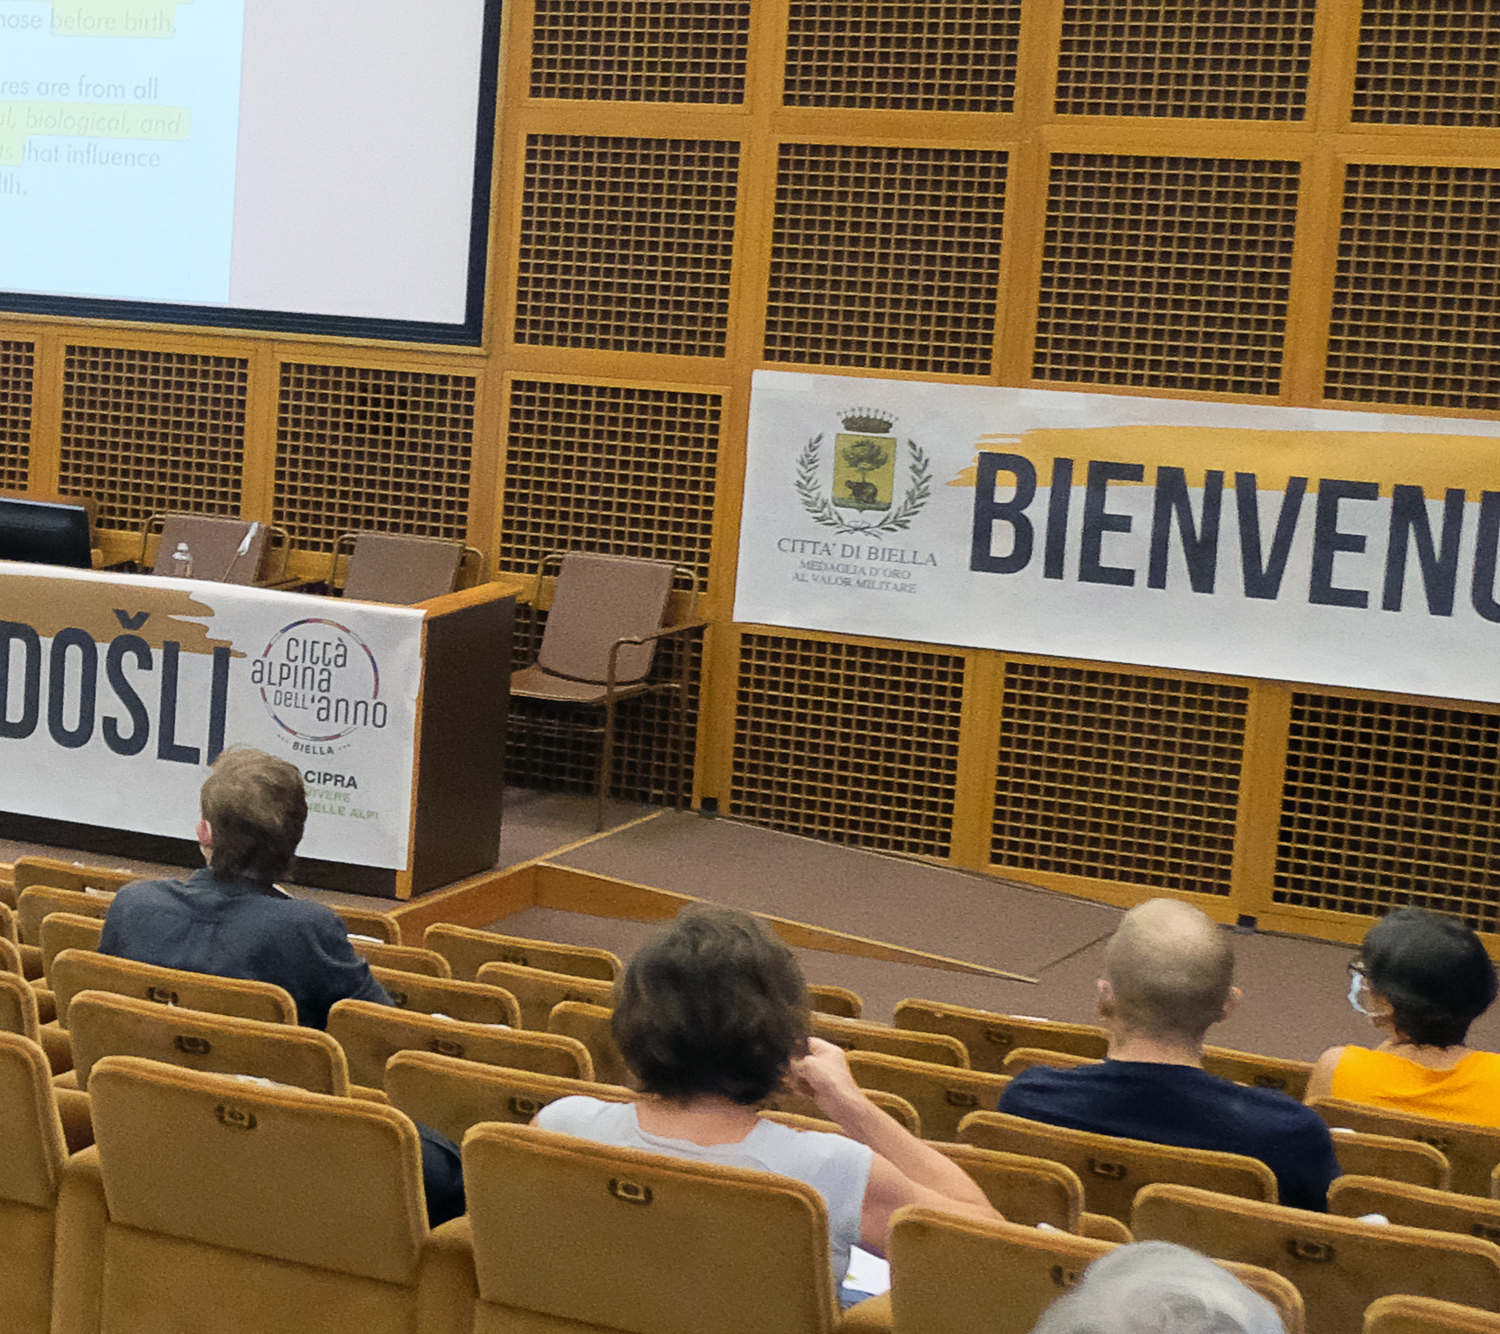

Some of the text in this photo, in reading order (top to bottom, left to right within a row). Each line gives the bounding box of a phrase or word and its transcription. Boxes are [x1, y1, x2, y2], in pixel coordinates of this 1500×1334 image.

[50, 7, 116, 32] before
[123, 9, 177, 33] birth.
[37, 80, 70, 97] are
[77, 74, 125, 99] from
[133, 77, 159, 100] all
[26, 107, 131, 136] biological,
[140, 112, 182, 134] and
[22, 140, 59, 163] that
[66, 143, 161, 168] influence
[841, 543, 860, 559] DI
[867, 546, 938, 566] BIELLA
[800, 559, 911, 580] MEDAGLIA D'ORO
[856, 578, 918, 594] MILITARE
[292, 741, 334, 755] BIELLA
[304, 770, 358, 789] CIPRA
